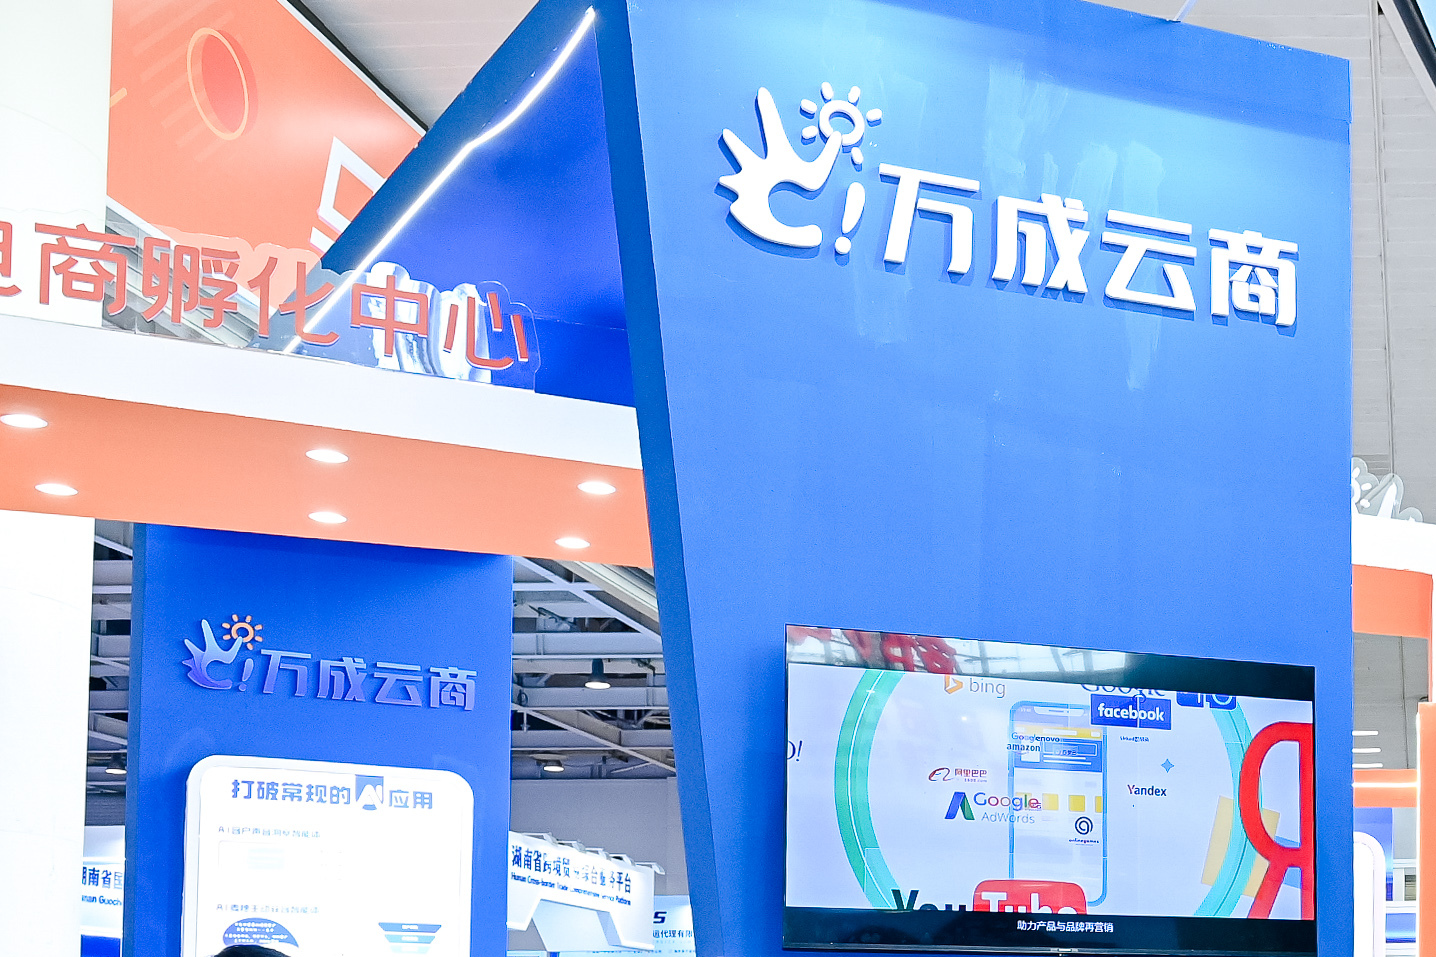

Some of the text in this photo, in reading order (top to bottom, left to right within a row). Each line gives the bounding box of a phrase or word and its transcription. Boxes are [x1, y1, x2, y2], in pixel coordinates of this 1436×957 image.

[878, 162, 1299, 327] 万成云商
[258, 647, 477, 711] 万成云商
[969, 677, 1006, 698] bing
[1098, 702, 1165, 722] facebook
[1006, 743, 1041, 752] amazon
[954, 768, 987, 778] 阿里巴巴
[1127, 784, 1167, 797] Yandex
[973, 792, 1040, 811] Google
[981, 811, 1035, 825] AdWords
[1016, 920, 1114, 933] 助力产品与品牌再营销
